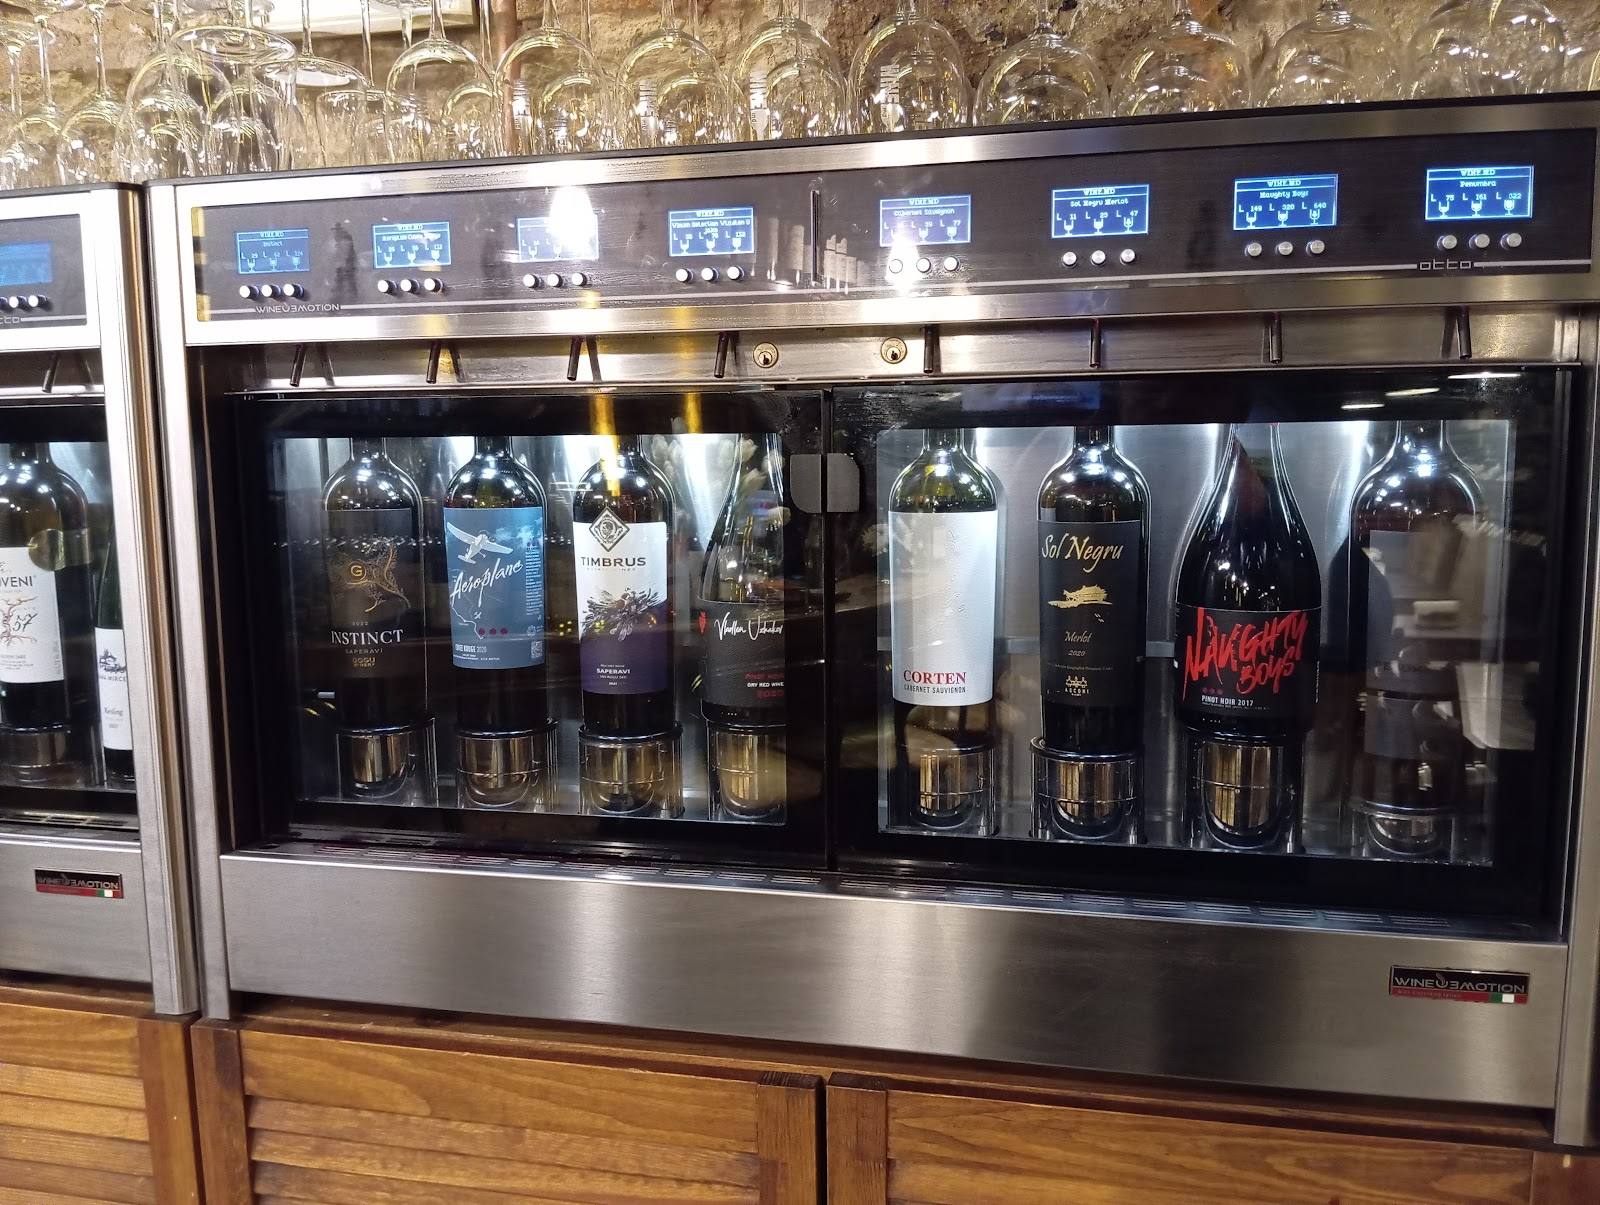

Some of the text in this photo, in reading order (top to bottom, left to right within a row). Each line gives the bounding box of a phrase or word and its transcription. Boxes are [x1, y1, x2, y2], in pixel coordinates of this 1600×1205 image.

[880, 65, 899, 104] WINE
[1260, 190, 1308, 199] Naughty Boys
[1420, 259, 1471, 270] otto
[1041, 533, 1123, 573] Sol Negru
[580, 557, 646, 567] TIMBRUS
[0, 576, 33, 588] VENI
[449, 557, 524, 608] Aeroplane
[331, 629, 404, 645] INSTINCT
[1065, 630, 1093, 643] Merlot
[1183, 607, 1309, 700] NAUGHTY
[903, 669, 966, 685] CORTEN
[904, 684, 966, 694] CABERNET SAUVIGNON
[1202, 695, 1219, 703] PINOT
